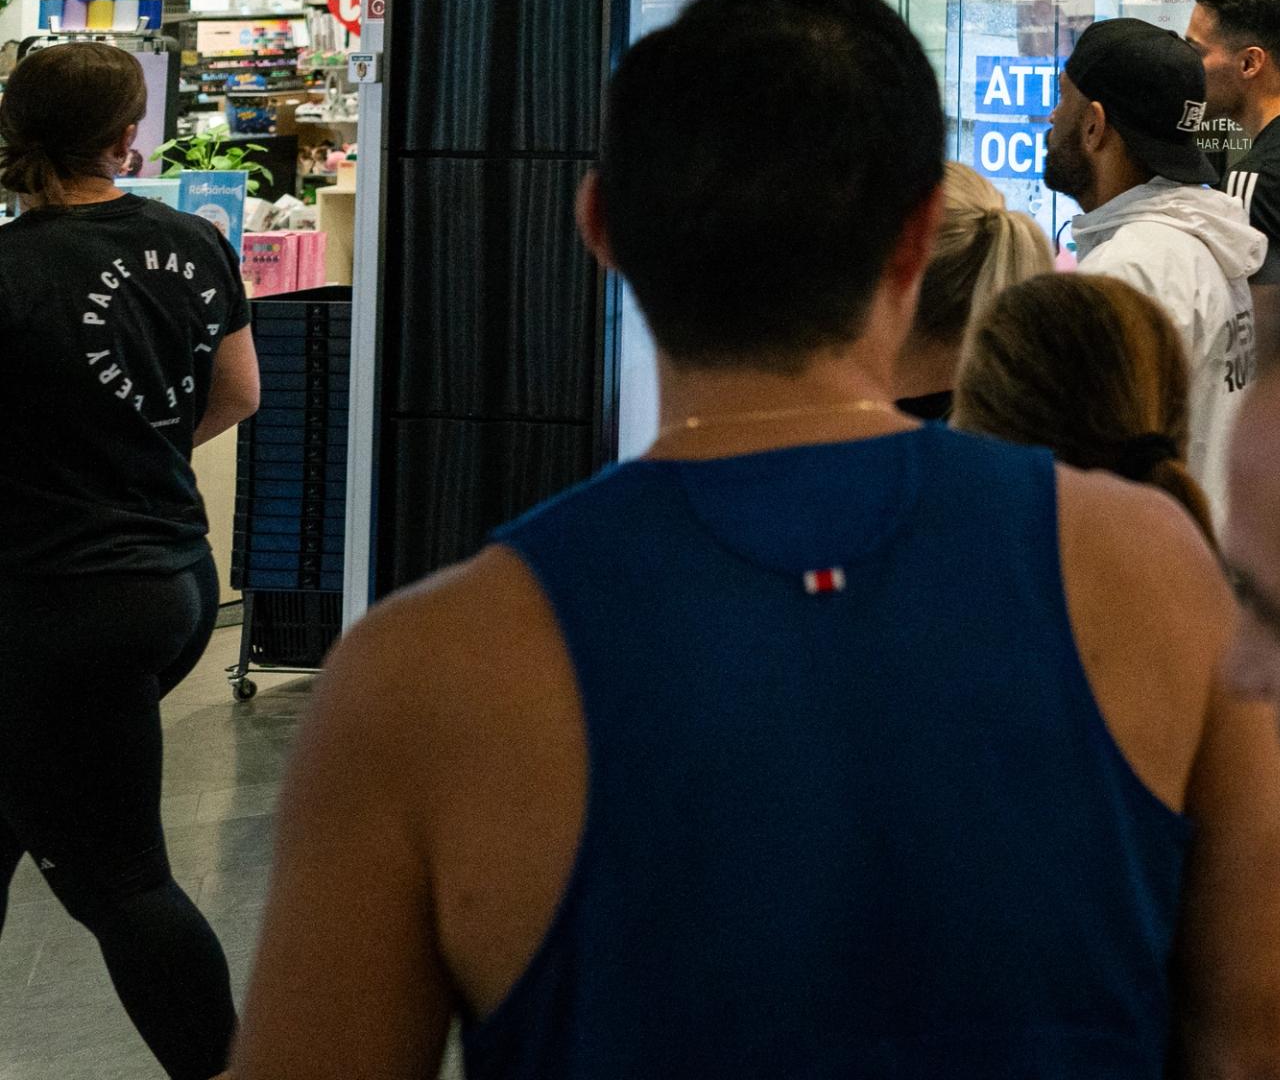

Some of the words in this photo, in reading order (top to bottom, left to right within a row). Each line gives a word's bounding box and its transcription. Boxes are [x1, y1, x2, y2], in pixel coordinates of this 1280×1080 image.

[983, 65, 1060, 107] ATT
[144, 250, 195, 279] HAS
[82, 258, 131, 325] PACE
[200, 288, 217, 304] A
[166, 324, 220, 408] PLCE
